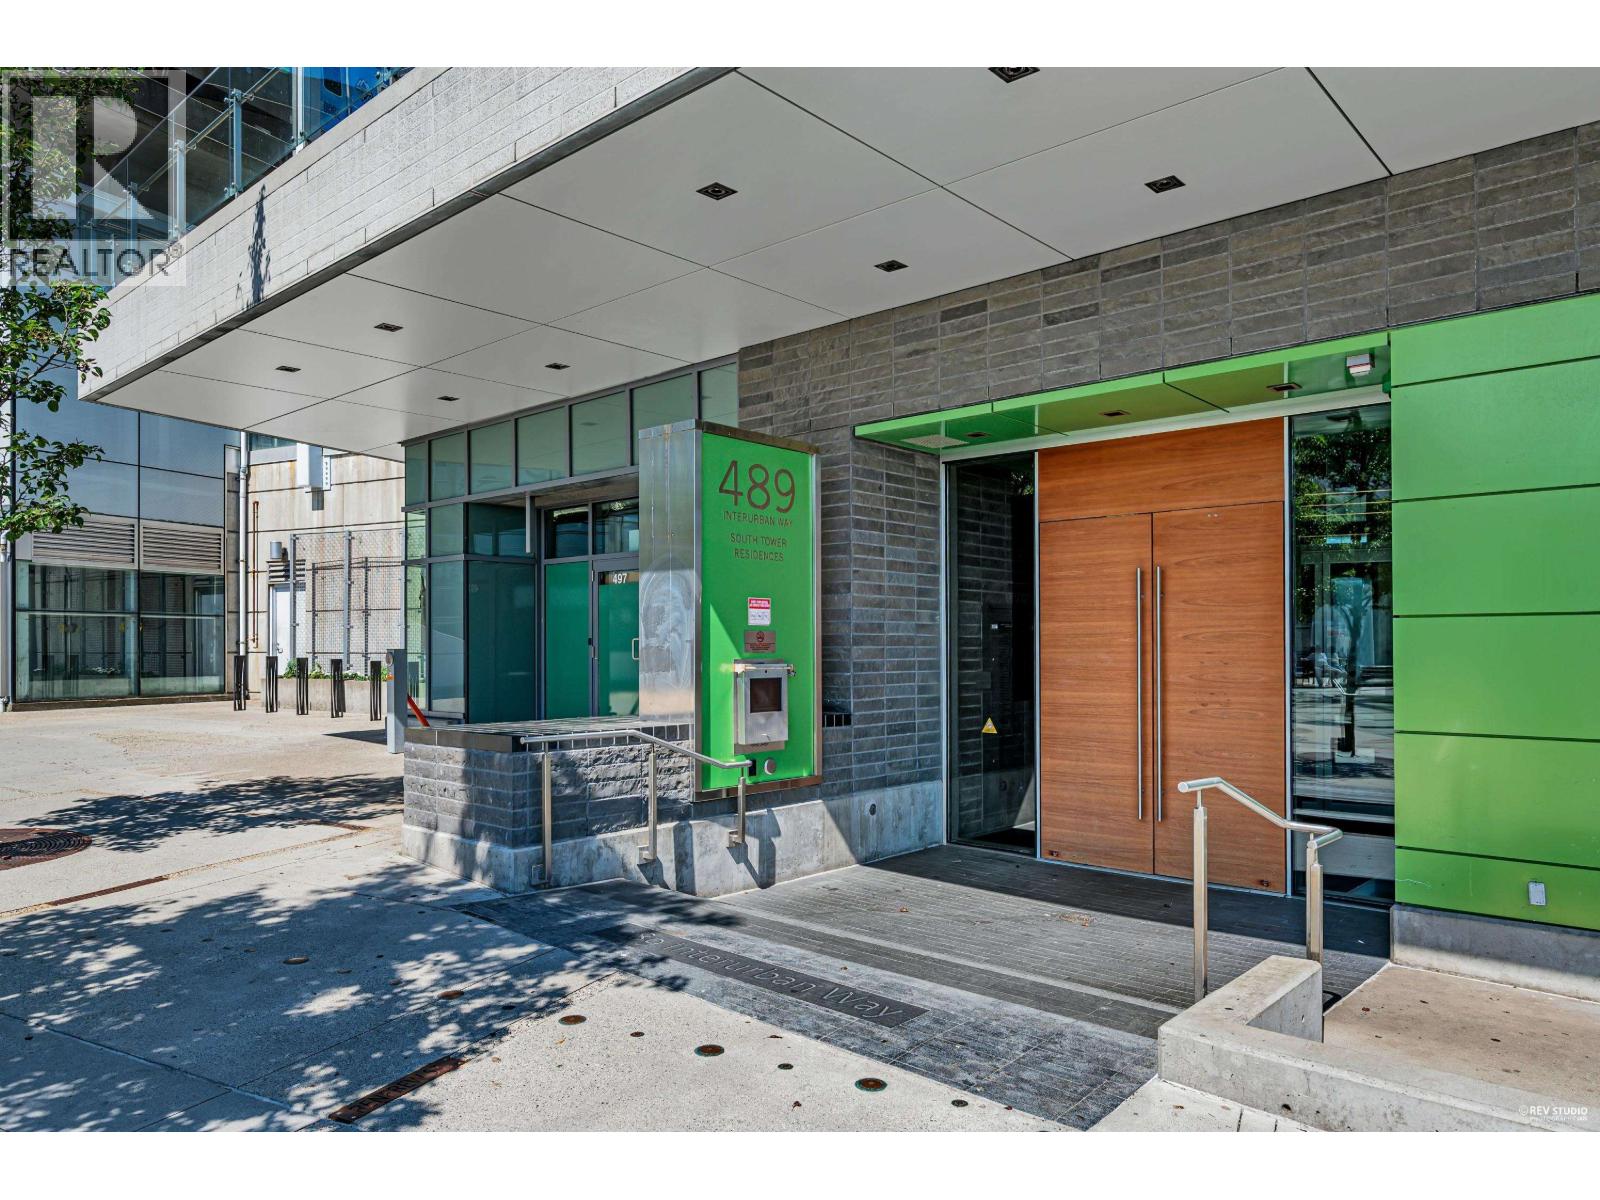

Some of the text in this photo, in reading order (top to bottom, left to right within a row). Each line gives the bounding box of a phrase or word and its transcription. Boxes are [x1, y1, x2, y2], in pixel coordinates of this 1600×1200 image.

[719, 459, 796, 513] 489
[723, 510, 793, 528] INTERURBAN WAY
[730, 532, 788, 548] SOUTH TOWER
[734, 547, 785, 562] RESIDENCES
[612, 573, 628, 585] 497
[822, 986, 905, 1019] Way
